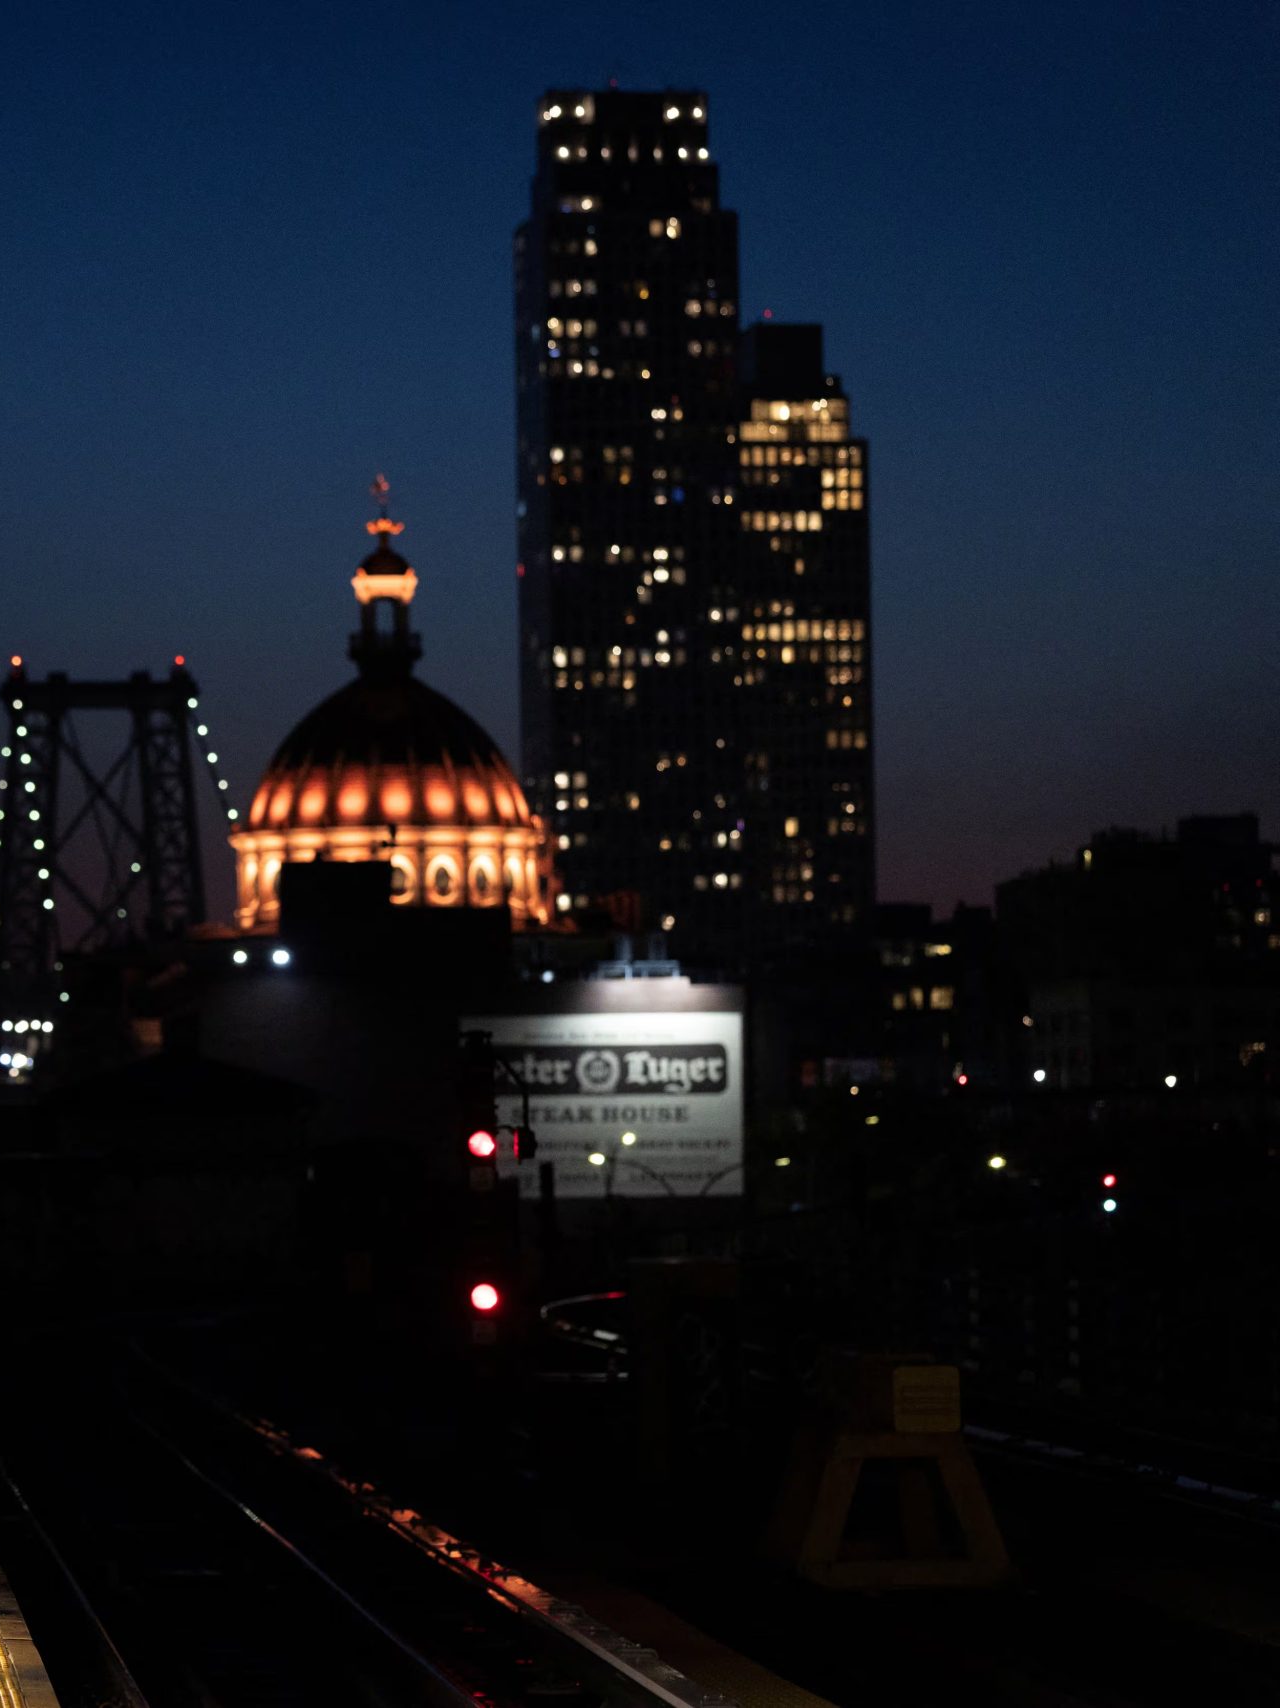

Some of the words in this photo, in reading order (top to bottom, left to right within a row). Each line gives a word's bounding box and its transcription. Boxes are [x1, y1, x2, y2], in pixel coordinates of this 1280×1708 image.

[494, 1054, 571, 1085] ter
[623, 1051, 724, 1093] Luger
[601, 1105, 689, 1123] HOUSE
